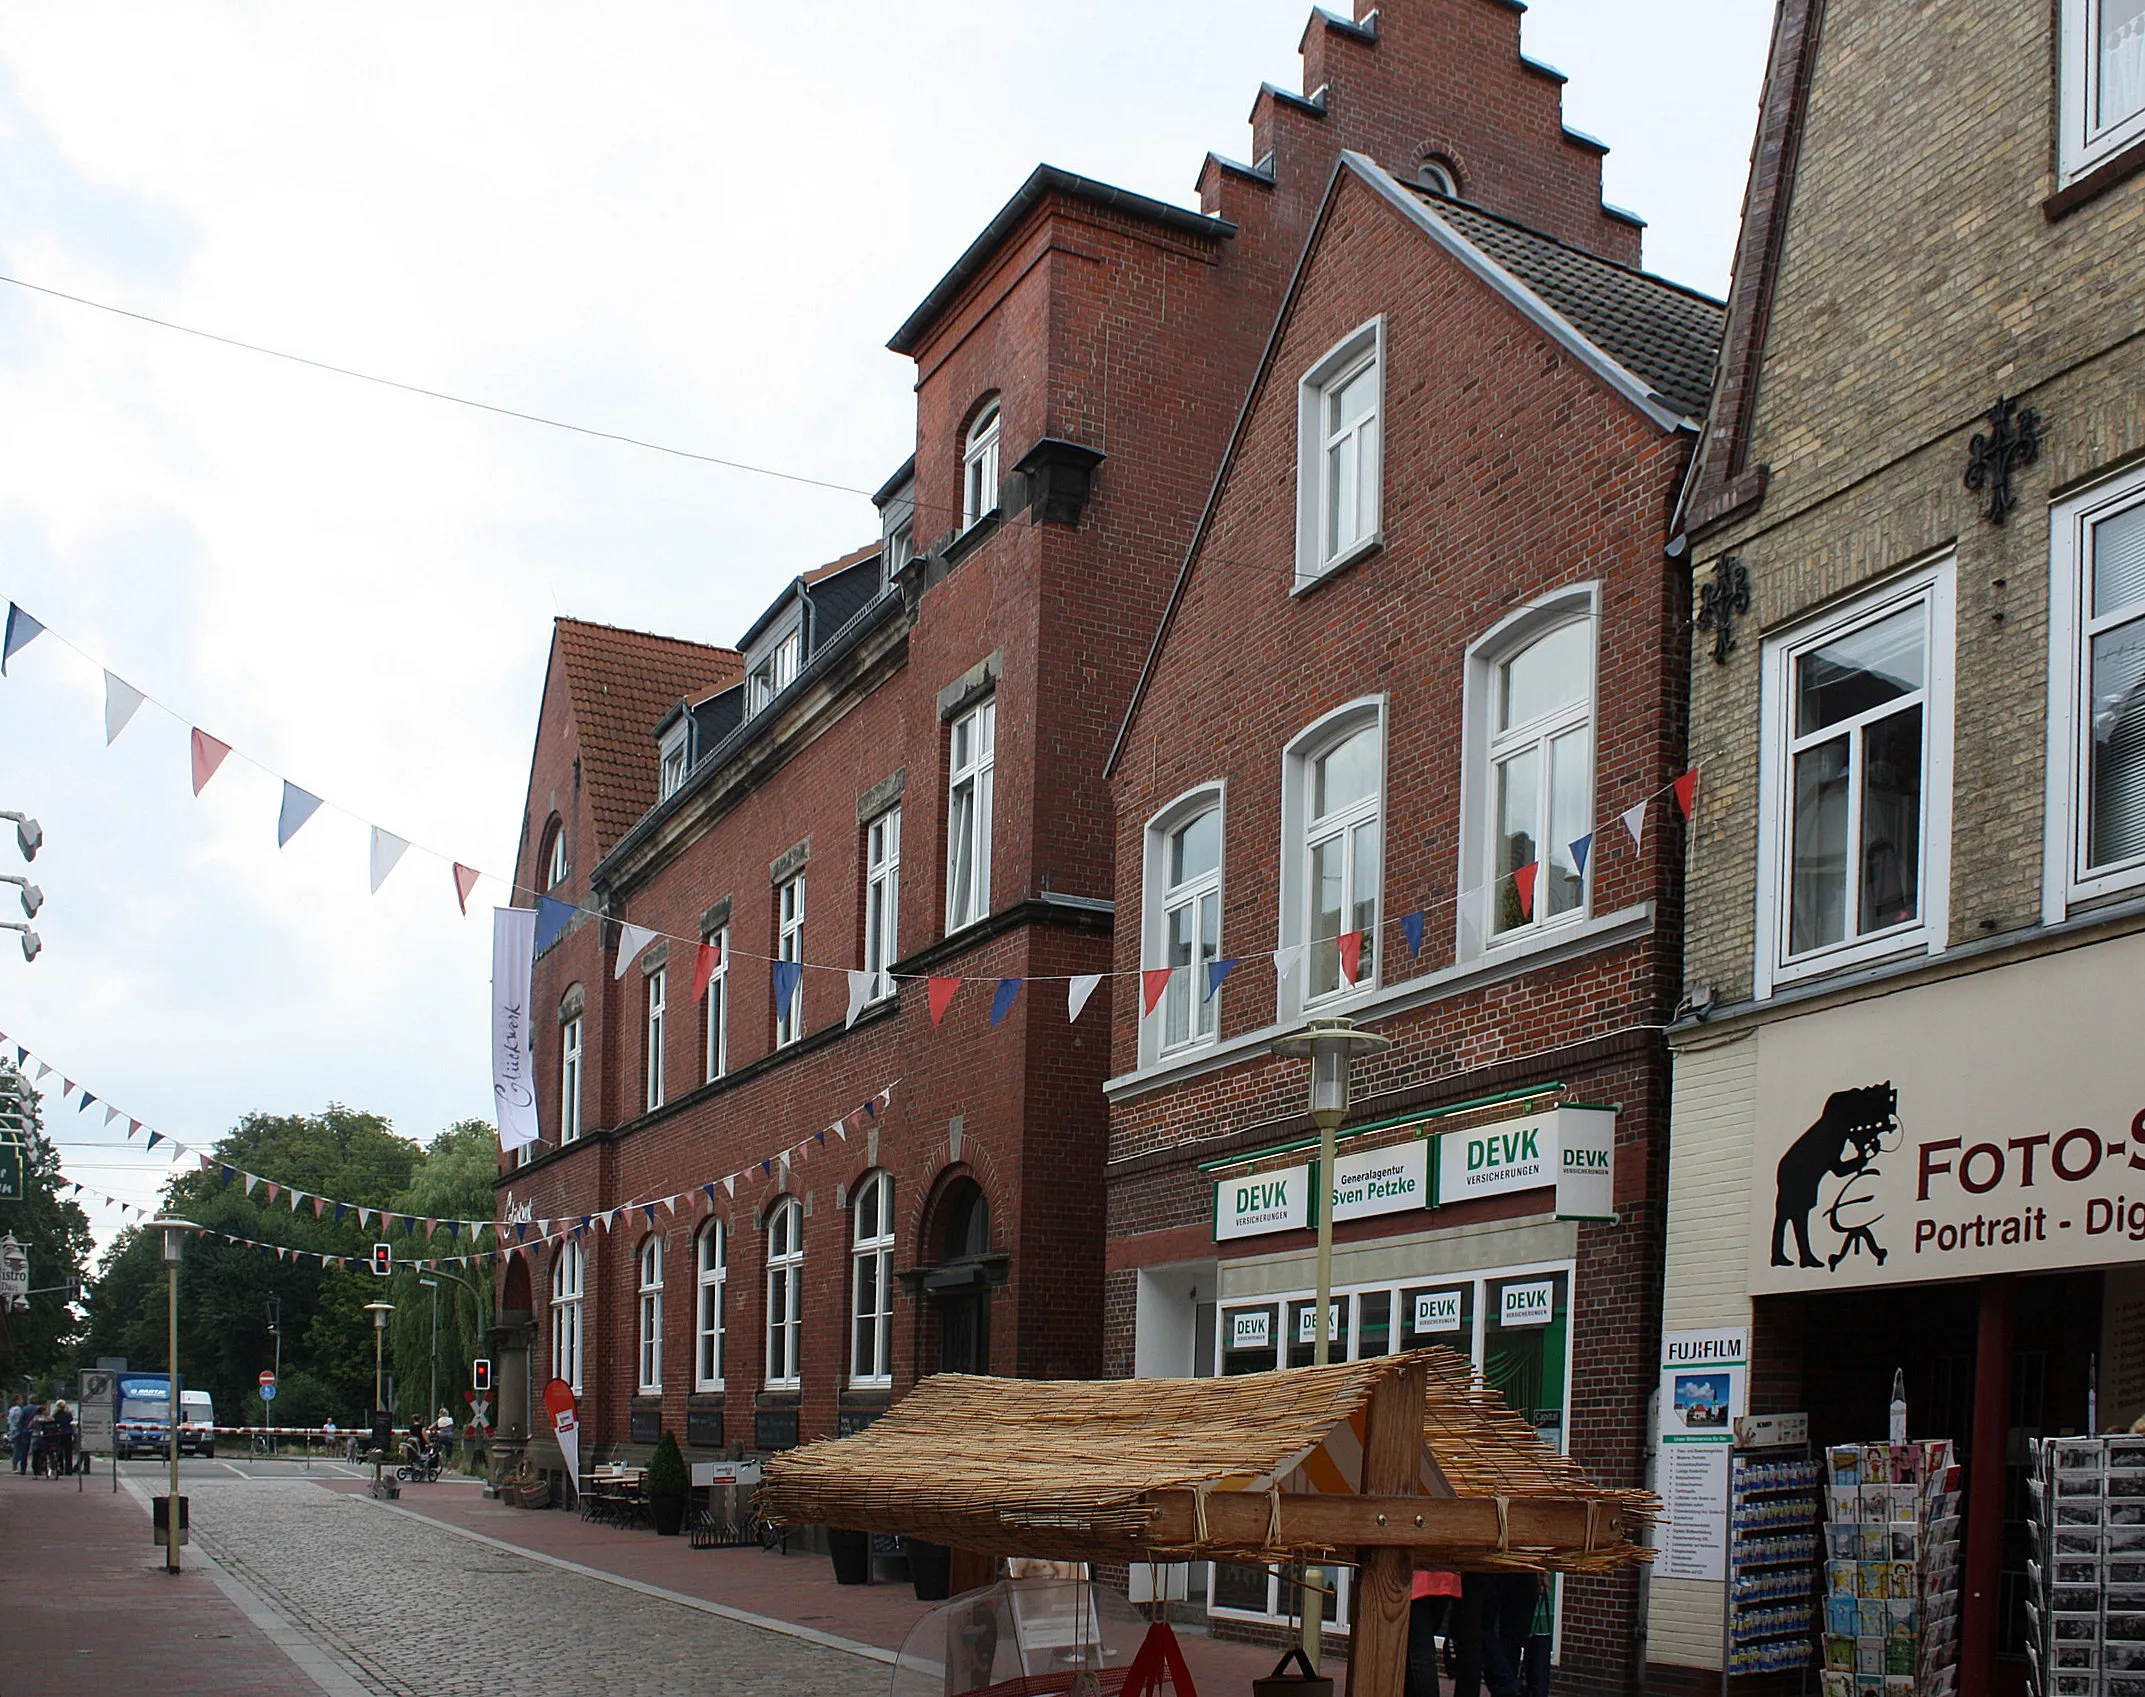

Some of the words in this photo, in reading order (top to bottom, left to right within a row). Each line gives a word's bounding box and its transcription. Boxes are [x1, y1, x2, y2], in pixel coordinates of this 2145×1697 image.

[1467, 1128, 1539, 1171] DEVK
[1563, 1149, 1609, 1168] DEVK
[1341, 1165, 1404, 1185] Generalagentur
[1466, 1165, 1540, 1186] VERSICHERUNGEN
[1563, 1168, 1609, 1176] VERSICHERUNGEN
[1236, 1180, 1287, 1214] DEVK
[1332, 1189, 1362, 1206] Sven
[1367, 1177, 1416, 1200] Petzke
[1236, 1211, 1288, 1227] VERSICHERUNGEN
[1915, 1207, 2046, 1253] Portrait
[0, 1268, 26, 1281] istro
[1420, 1299, 1455, 1318] DEVK
[1506, 1289, 1547, 1310] DEVK
[1304, 1312, 1334, 1329] DEK
[1419, 1317, 1456, 1326] VERSICHERUNGEN
[1506, 1309, 1547, 1319] VERSICHERUNGEN
[1237, 1319, 1265, 1334] DEVK
[1669, 1339, 1741, 1360] FUJIFILM
